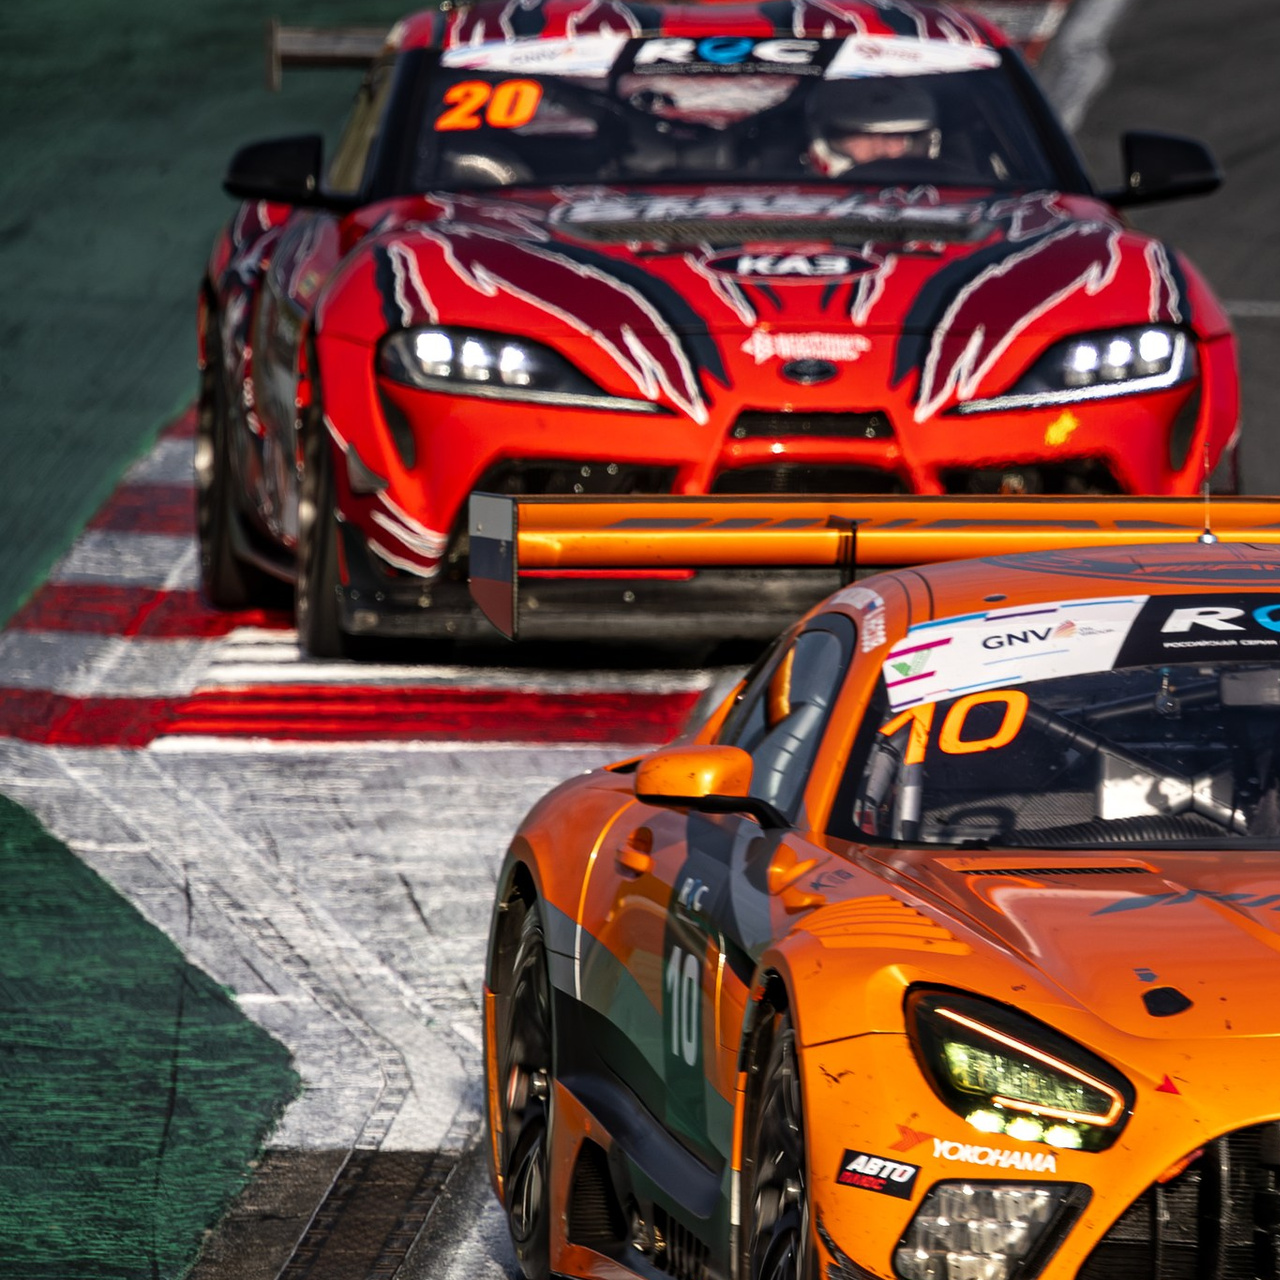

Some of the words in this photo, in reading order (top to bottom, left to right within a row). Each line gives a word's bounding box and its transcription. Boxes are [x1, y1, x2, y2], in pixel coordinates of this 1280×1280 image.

[434, 78, 544, 132] 20
[981, 626, 1056, 650] GNV
[879, 689, 1029, 765] 10
[666, 945, 699, 1067] 10
[845, 1154, 916, 1183] АВТО
[931, 1137, 1057, 1174] YOKOHAMA
